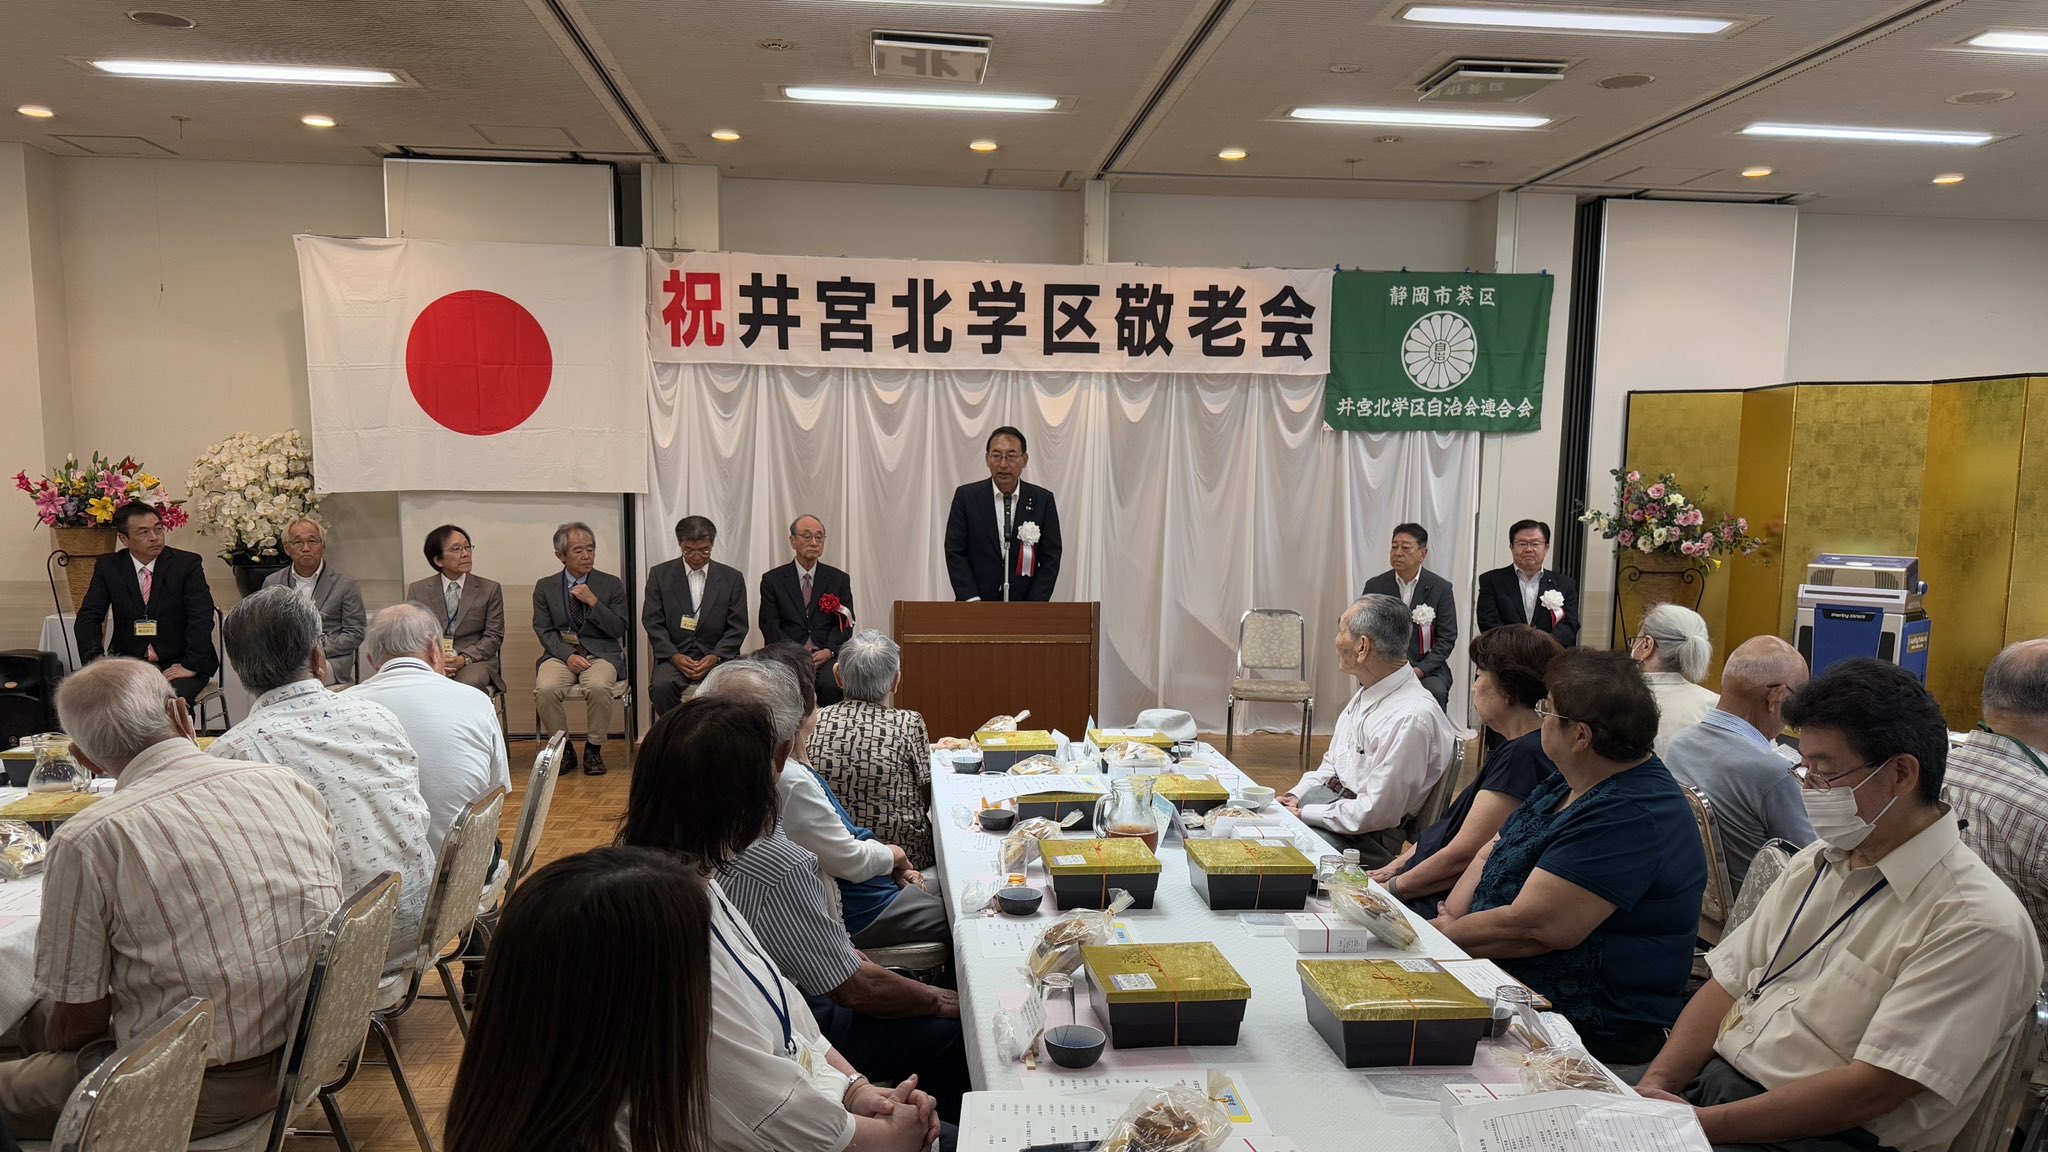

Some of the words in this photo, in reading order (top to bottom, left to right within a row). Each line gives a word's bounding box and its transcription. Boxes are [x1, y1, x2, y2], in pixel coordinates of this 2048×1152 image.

[1389, 284, 1496, 307] 静岡市葵区
[1336, 396, 1534, 418] 井宮北学区自治会連合会
